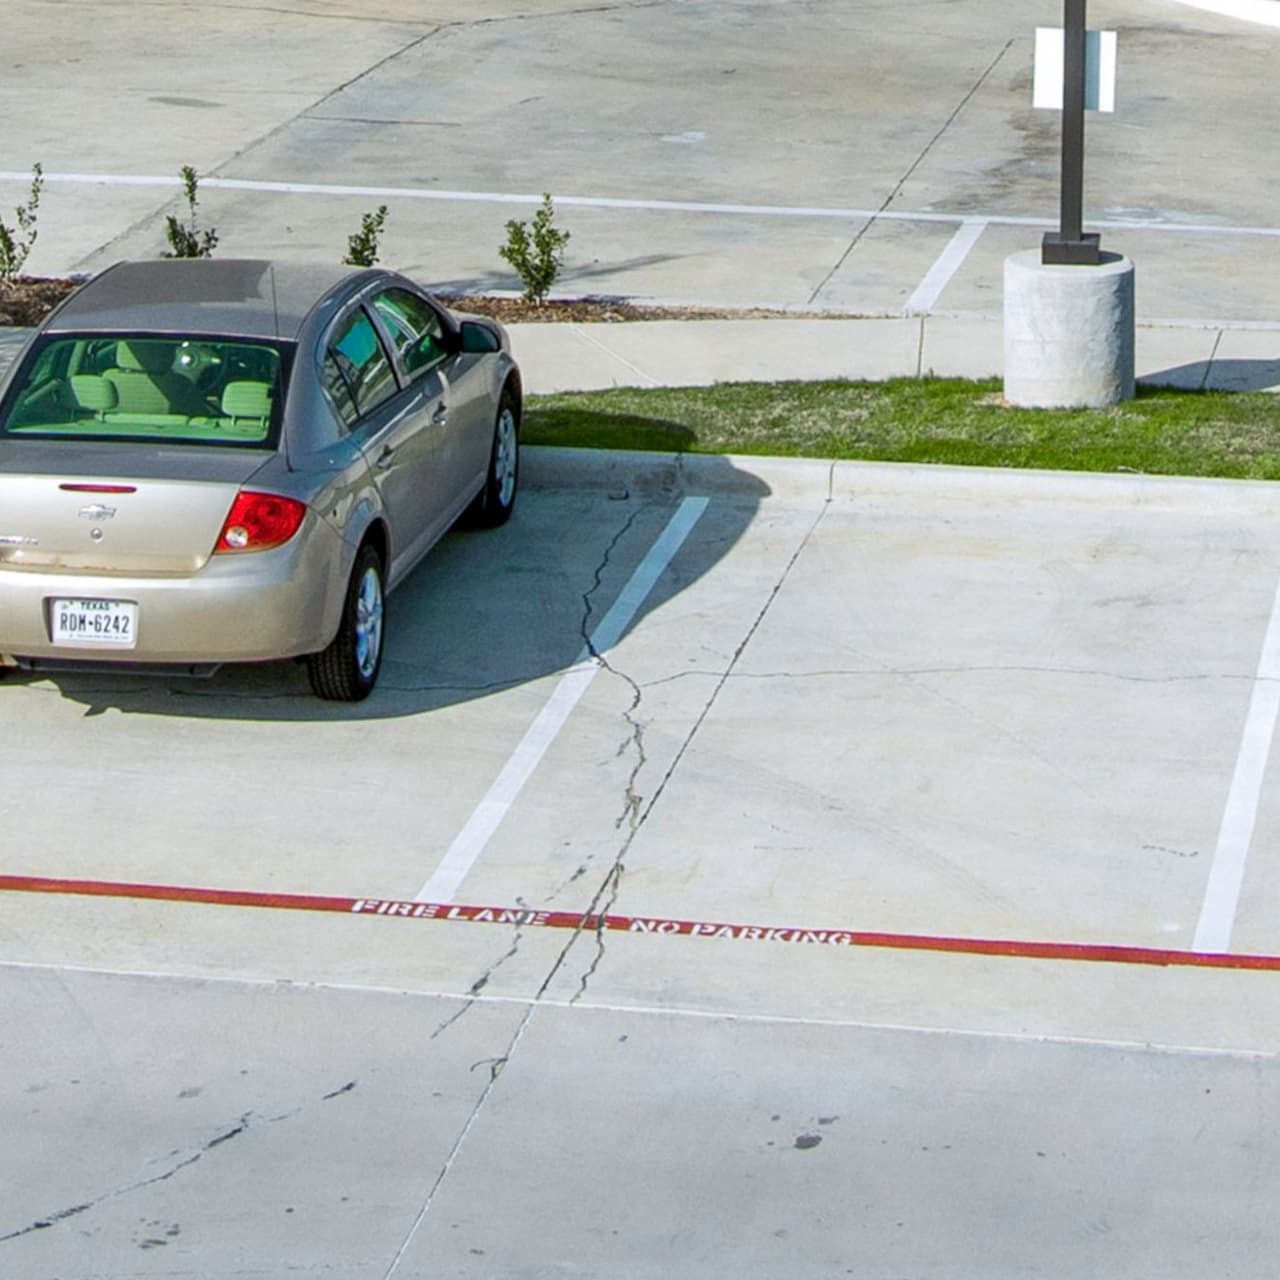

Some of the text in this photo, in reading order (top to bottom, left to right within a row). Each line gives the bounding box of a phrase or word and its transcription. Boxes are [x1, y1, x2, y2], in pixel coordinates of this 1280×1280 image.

[81, 601, 110, 610] TEXAS
[352, 900, 852, 945] FIRE LANE NO PARKING
